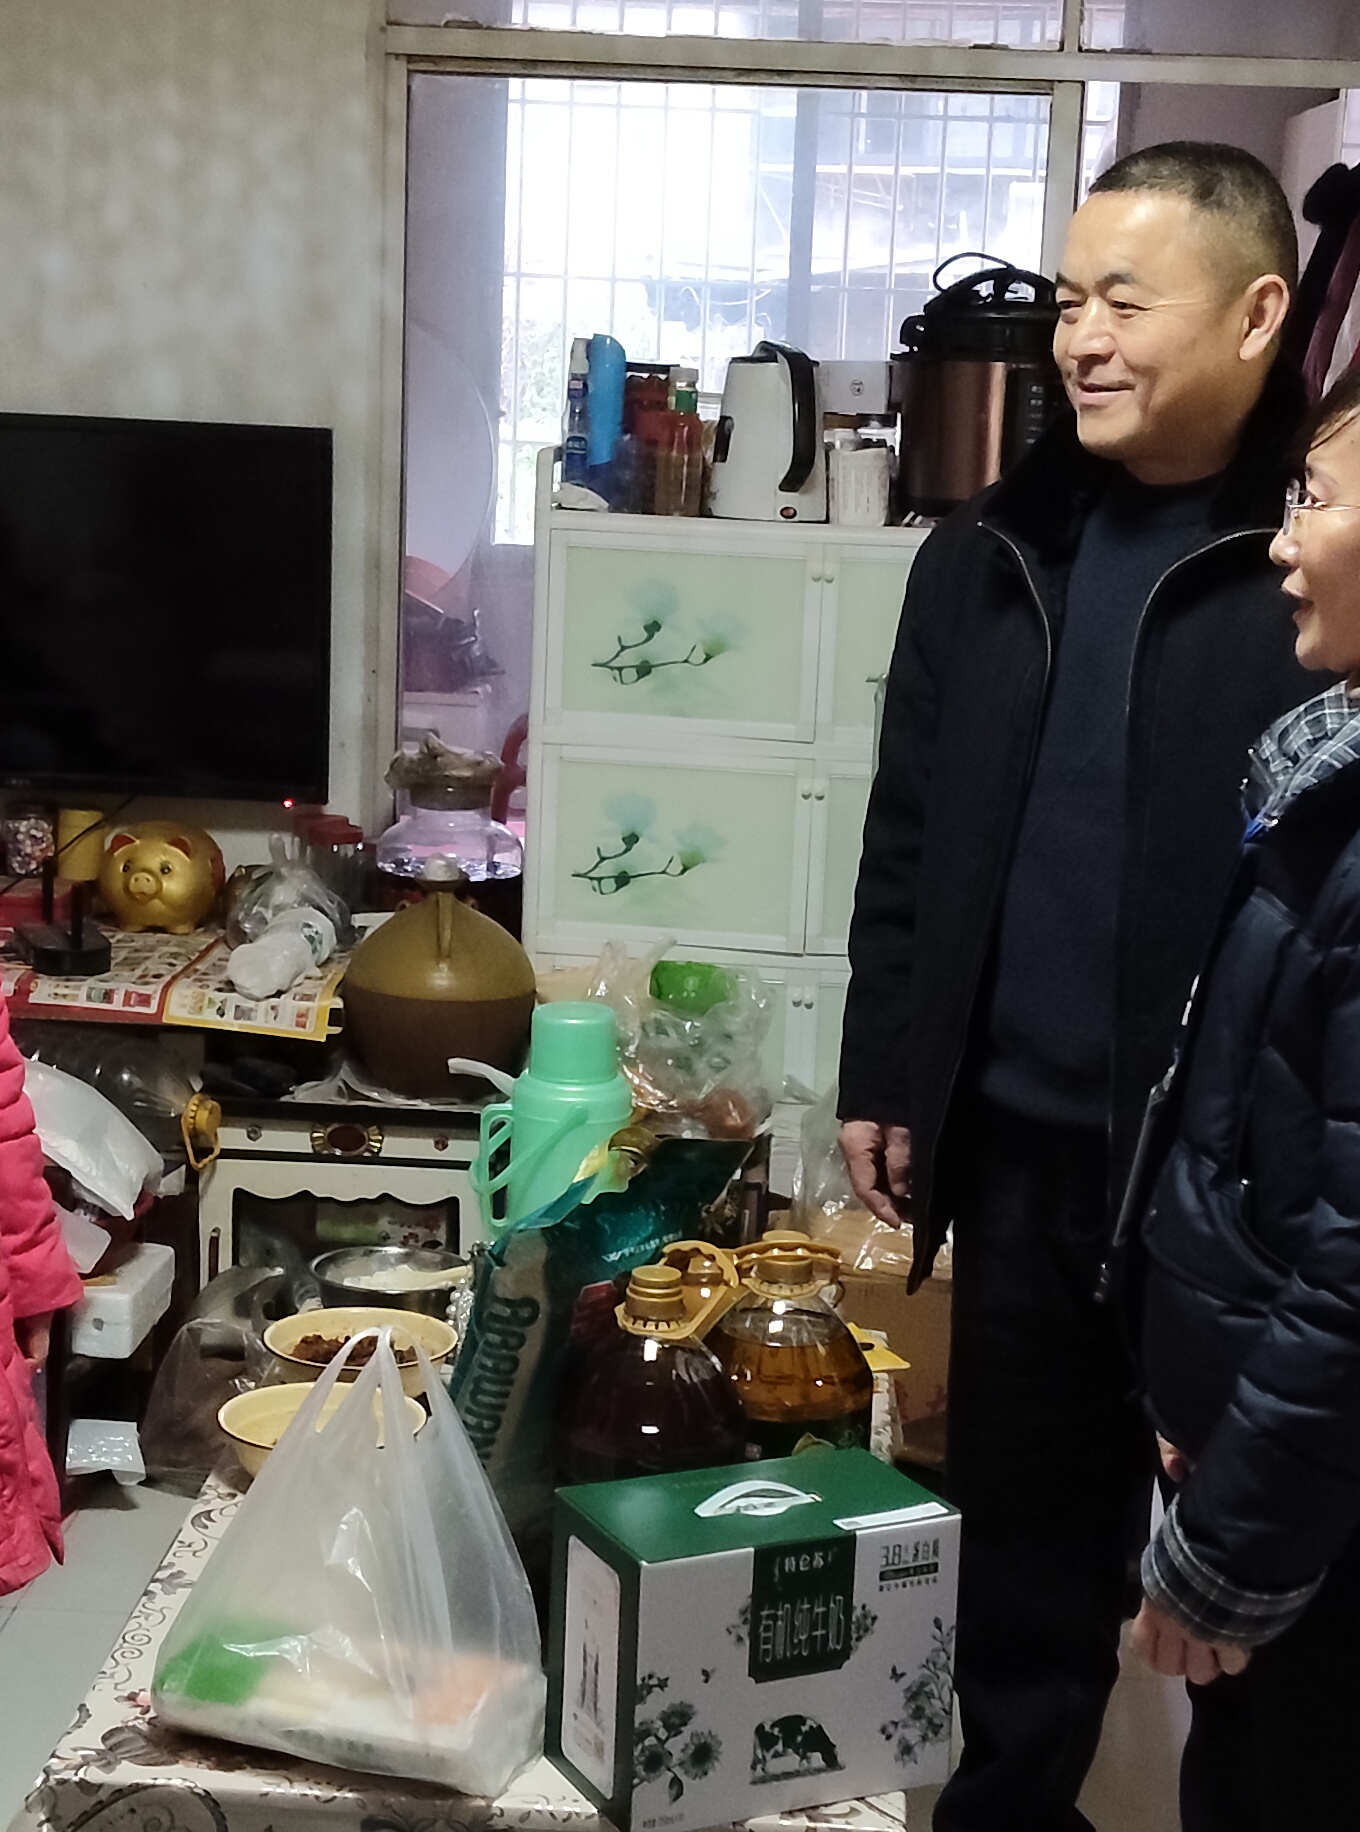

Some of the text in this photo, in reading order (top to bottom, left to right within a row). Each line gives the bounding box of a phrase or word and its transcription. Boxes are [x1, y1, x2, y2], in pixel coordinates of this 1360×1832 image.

[759, 1593, 845, 1664] 有机纯牛奶
